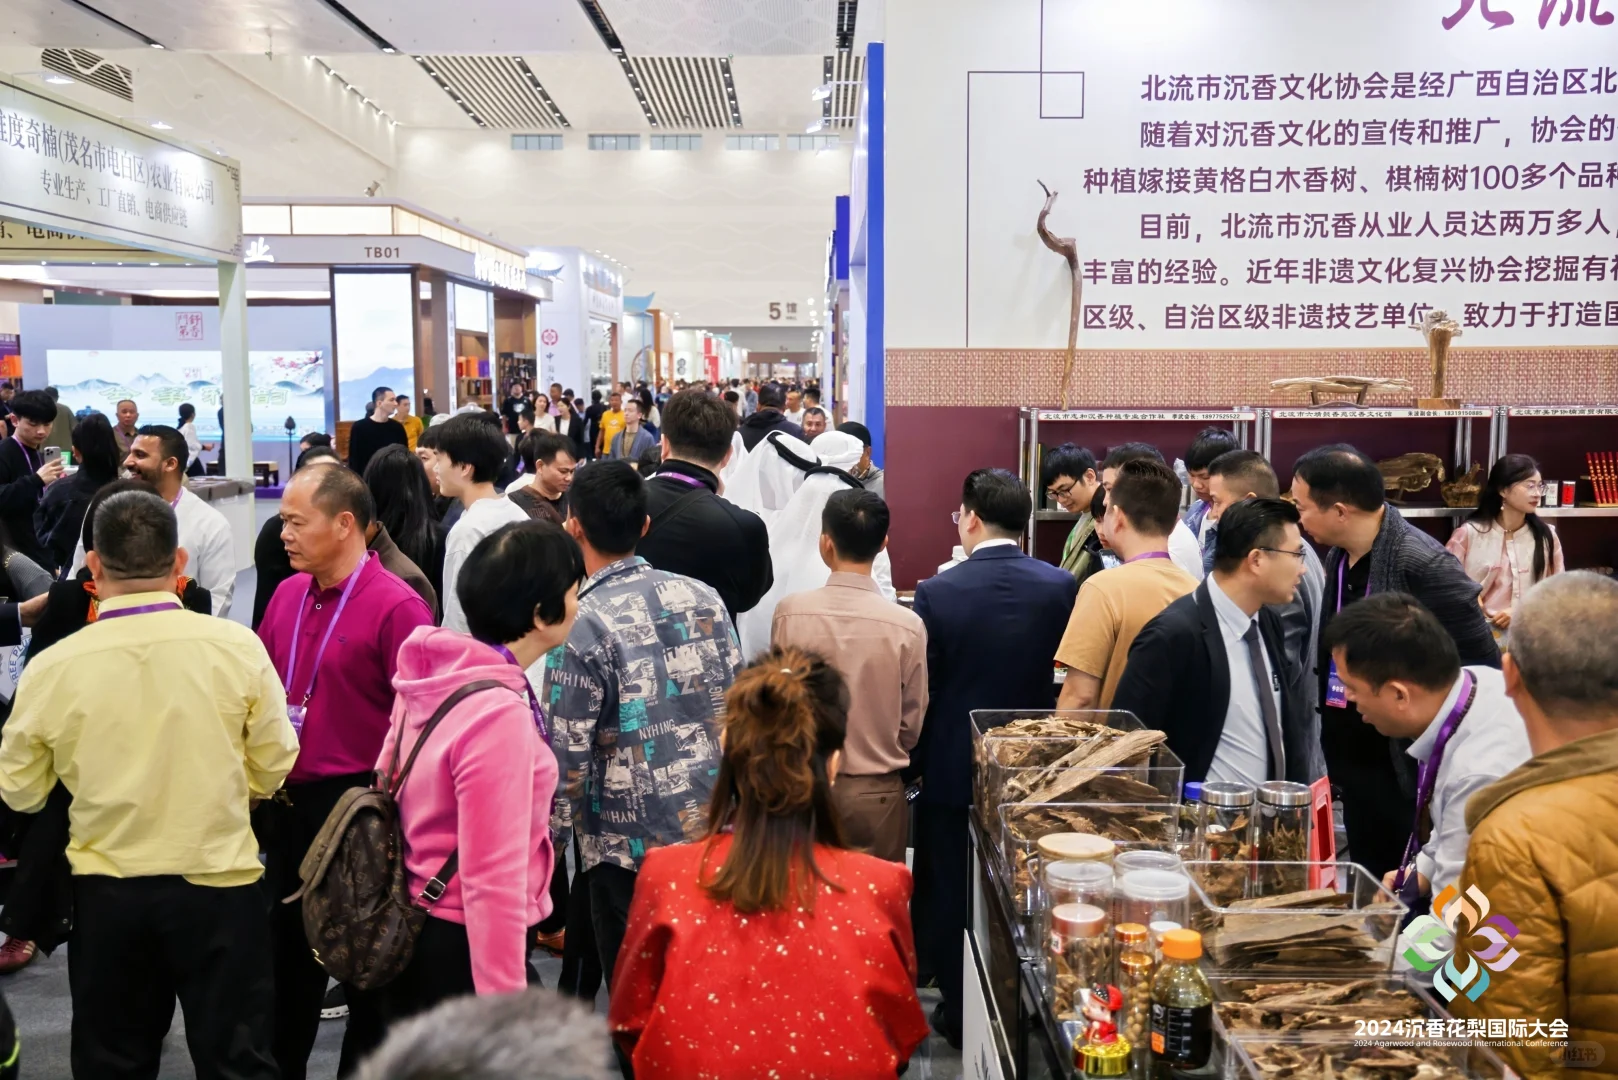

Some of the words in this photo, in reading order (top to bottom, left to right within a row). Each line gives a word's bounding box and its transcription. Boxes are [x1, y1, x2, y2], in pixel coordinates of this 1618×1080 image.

[1141, 66, 1618, 101] 北流市沉香文化协会是经广西自治区北
[1140, 114, 1618, 148] 随着对沉香文化的宣传和推广，协会的
[364, 247, 400, 259] TB01
[1083, 255, 1618, 287] 丰富的经验。近年非遗文化复兴协会挖掘有
[769, 302, 782, 320] 5
[551, 669, 595, 691] NYHING
[639, 719, 676, 740] NYHING
